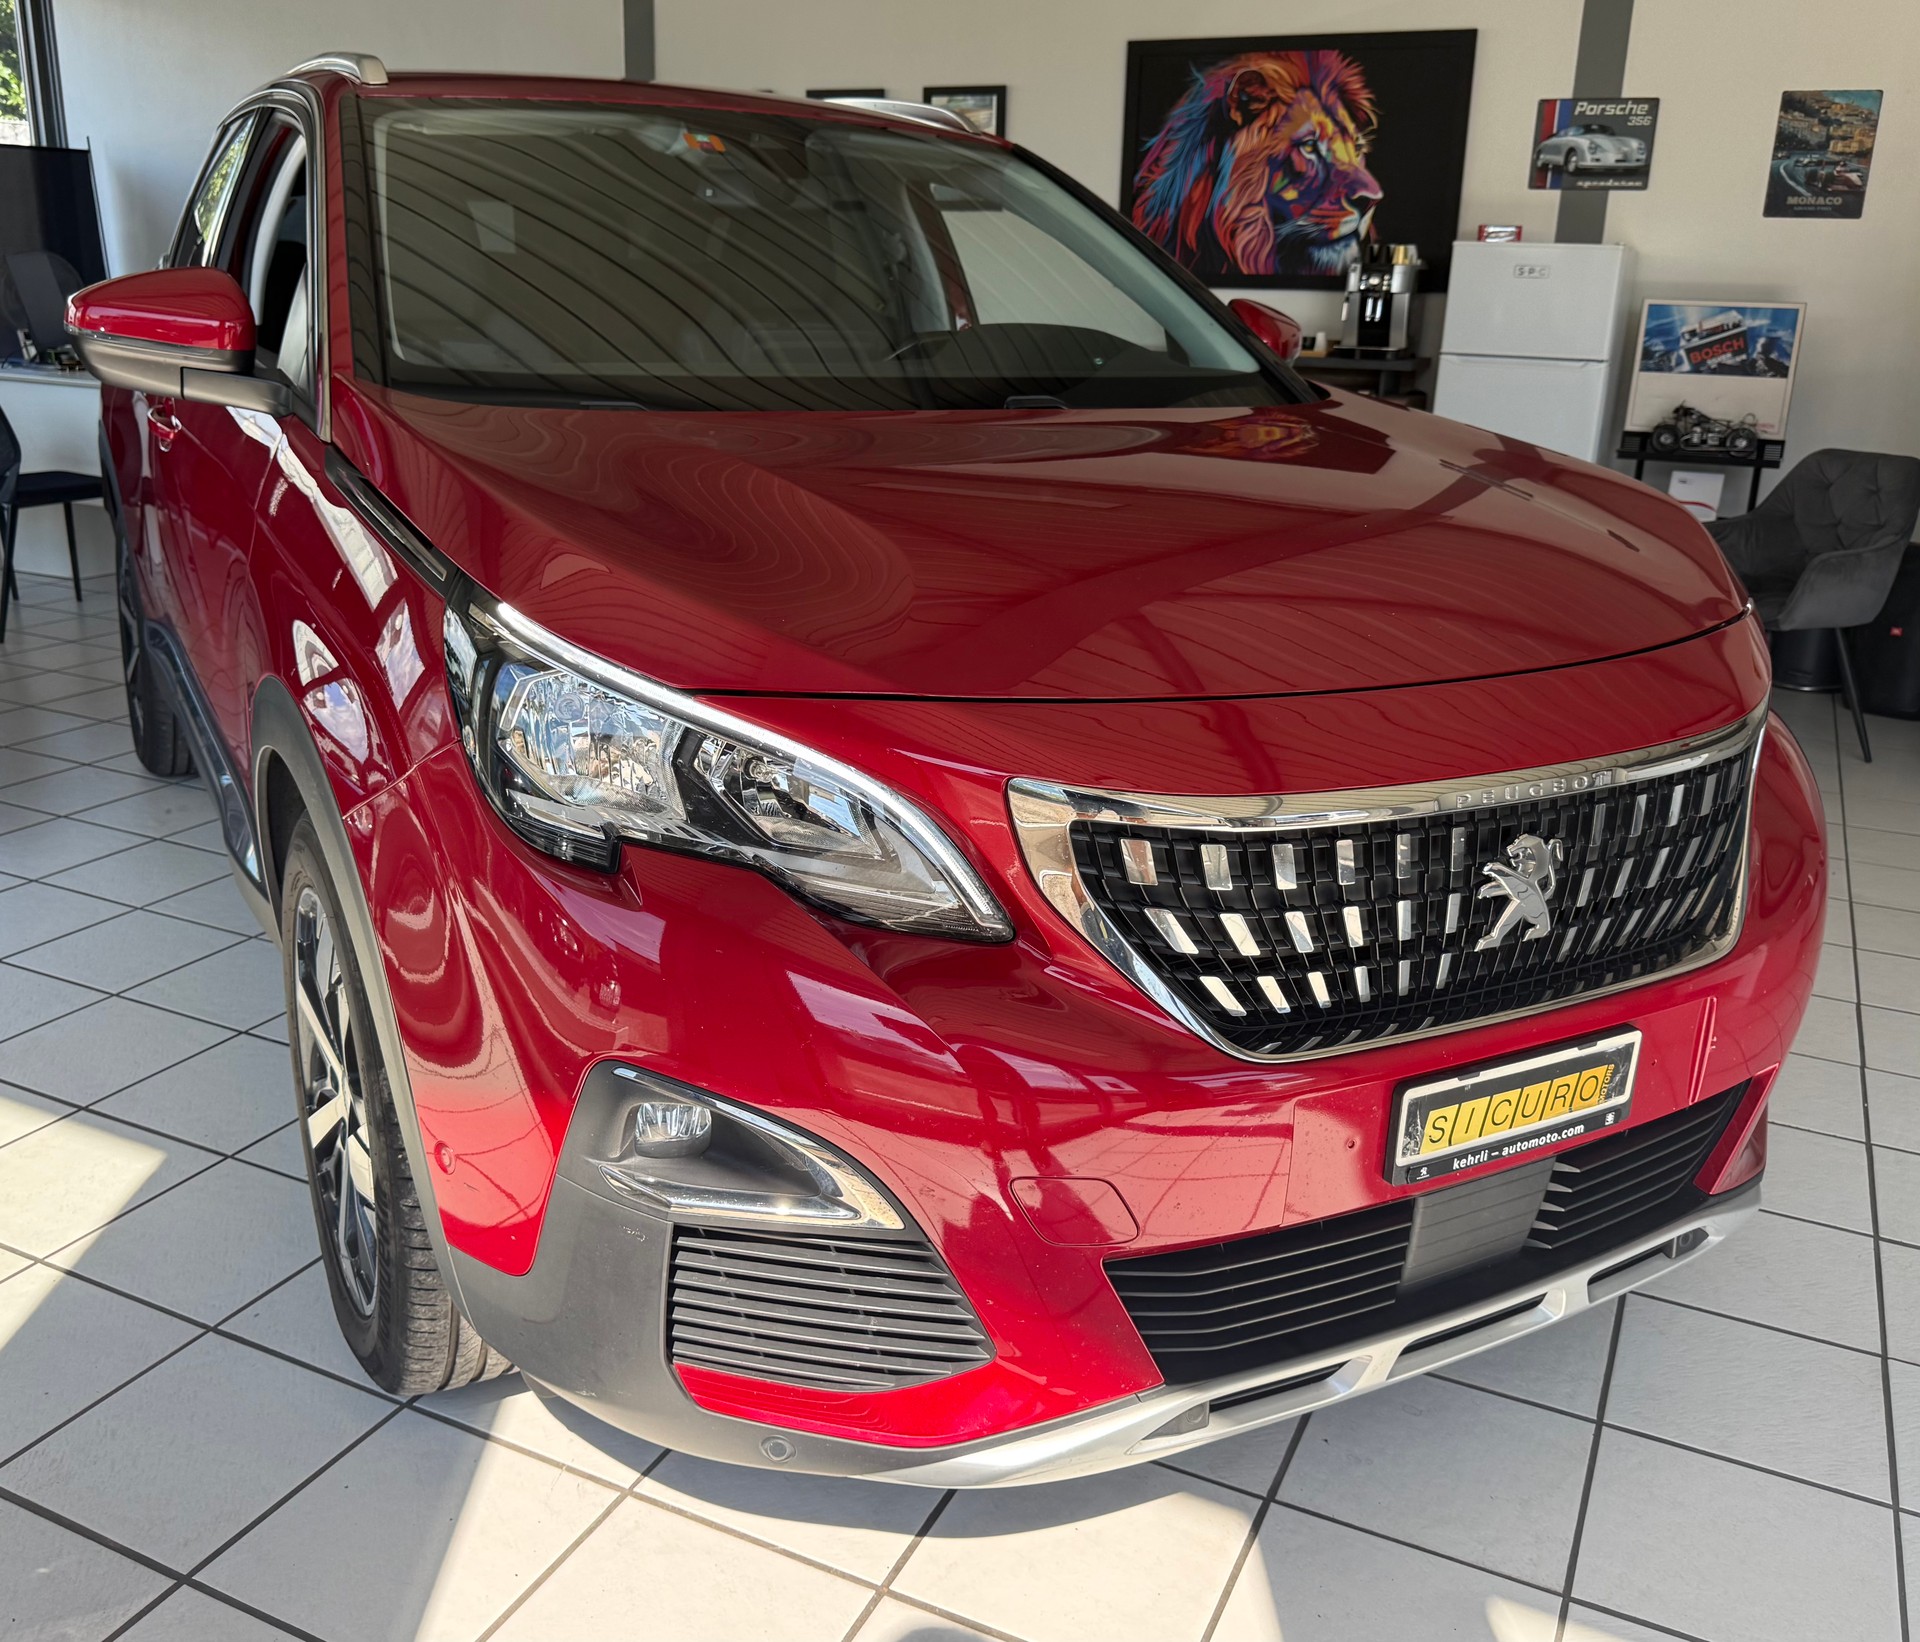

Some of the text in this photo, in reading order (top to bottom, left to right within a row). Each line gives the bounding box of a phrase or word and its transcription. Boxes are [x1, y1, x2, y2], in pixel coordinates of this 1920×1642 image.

[1574, 100, 1649, 116] Porsche
[1626, 115, 1653, 126] 356
[1786, 195, 1843, 206] MONACO
[1689, 337, 1745, 364] BOSCH
[1456, 770, 1612, 809] PEUGEOT
[1428, 1074, 1600, 1144] SICURO
[1453, 1150, 1489, 1170] kehrli
[1502, 1124, 1585, 1156] automoto.com
